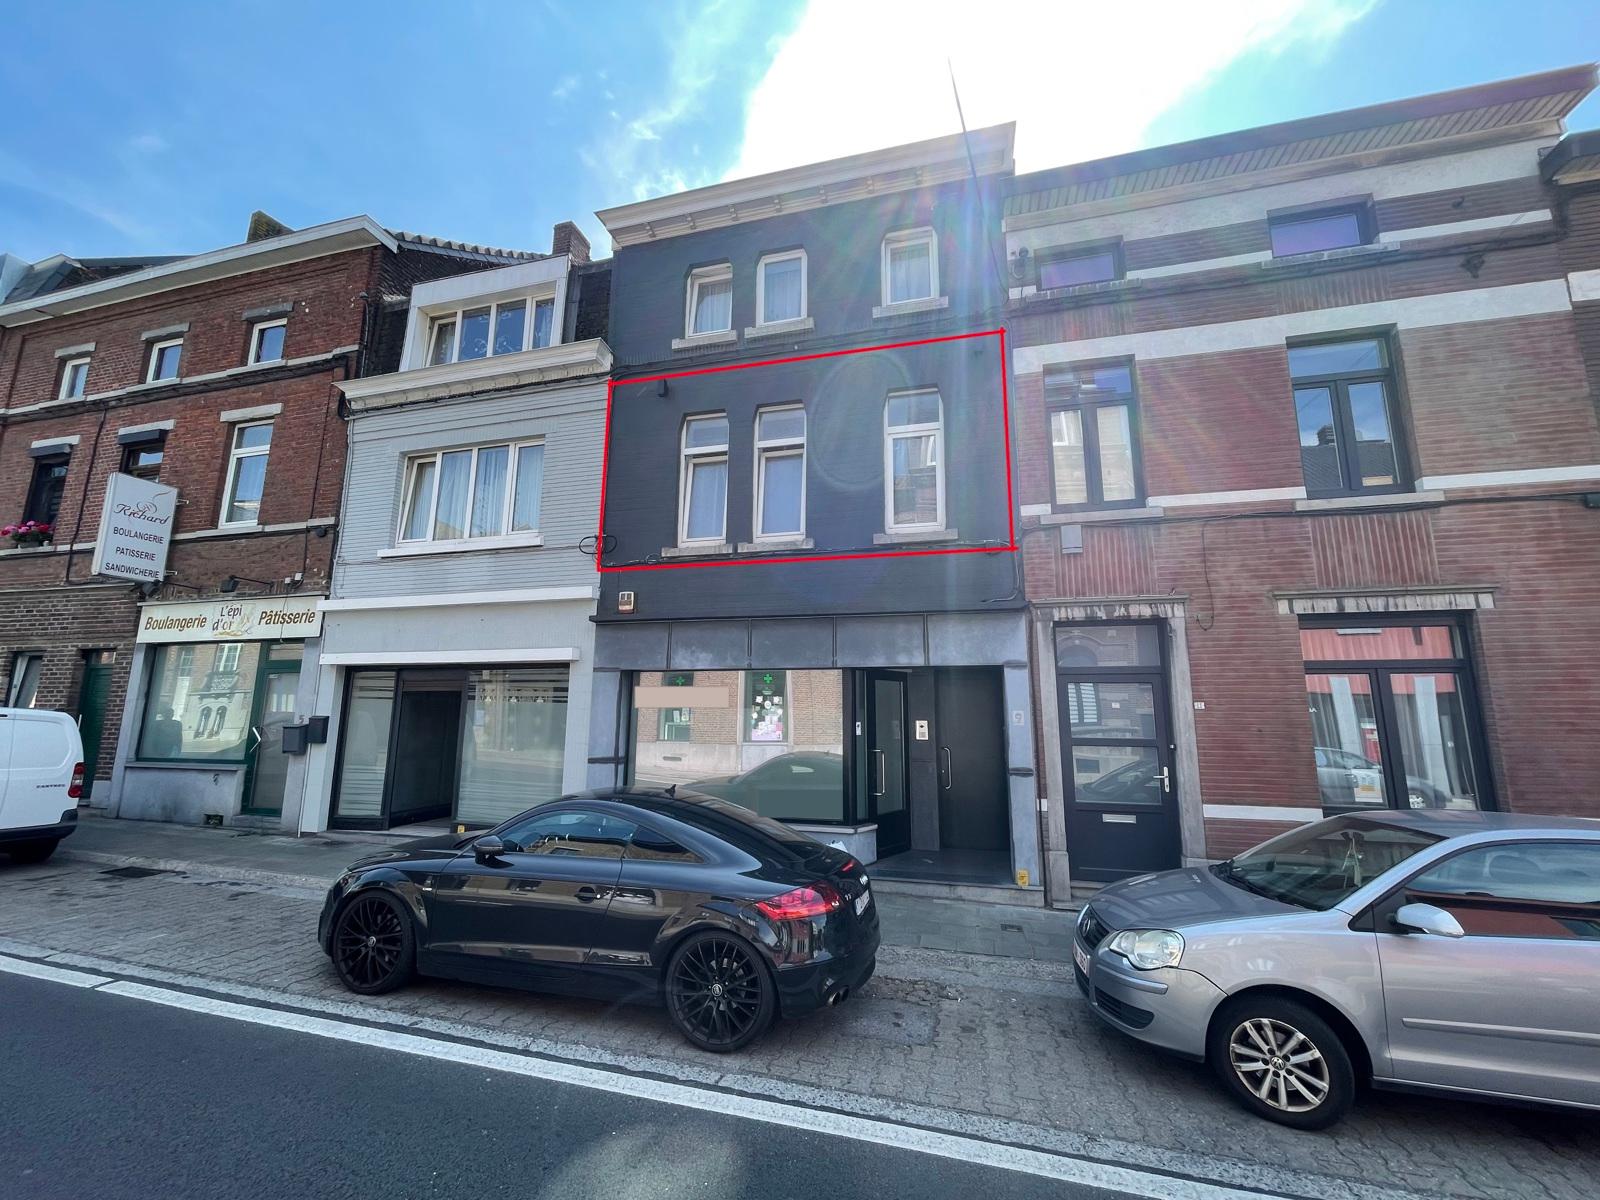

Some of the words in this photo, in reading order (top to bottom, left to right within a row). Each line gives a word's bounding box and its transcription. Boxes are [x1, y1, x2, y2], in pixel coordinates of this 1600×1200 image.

[113, 503, 171, 525] Richard
[113, 526, 164, 545] BOULANGERIE
[115, 546, 156, 561] PATISSERIE
[105, 562, 160, 579] SANDWICHERIE
[220, 604, 243, 620] L'épi
[258, 609, 316, 626] Pâtisserie
[144, 614, 207, 632] Boulangerie
[212, 618, 234, 631] d'or
